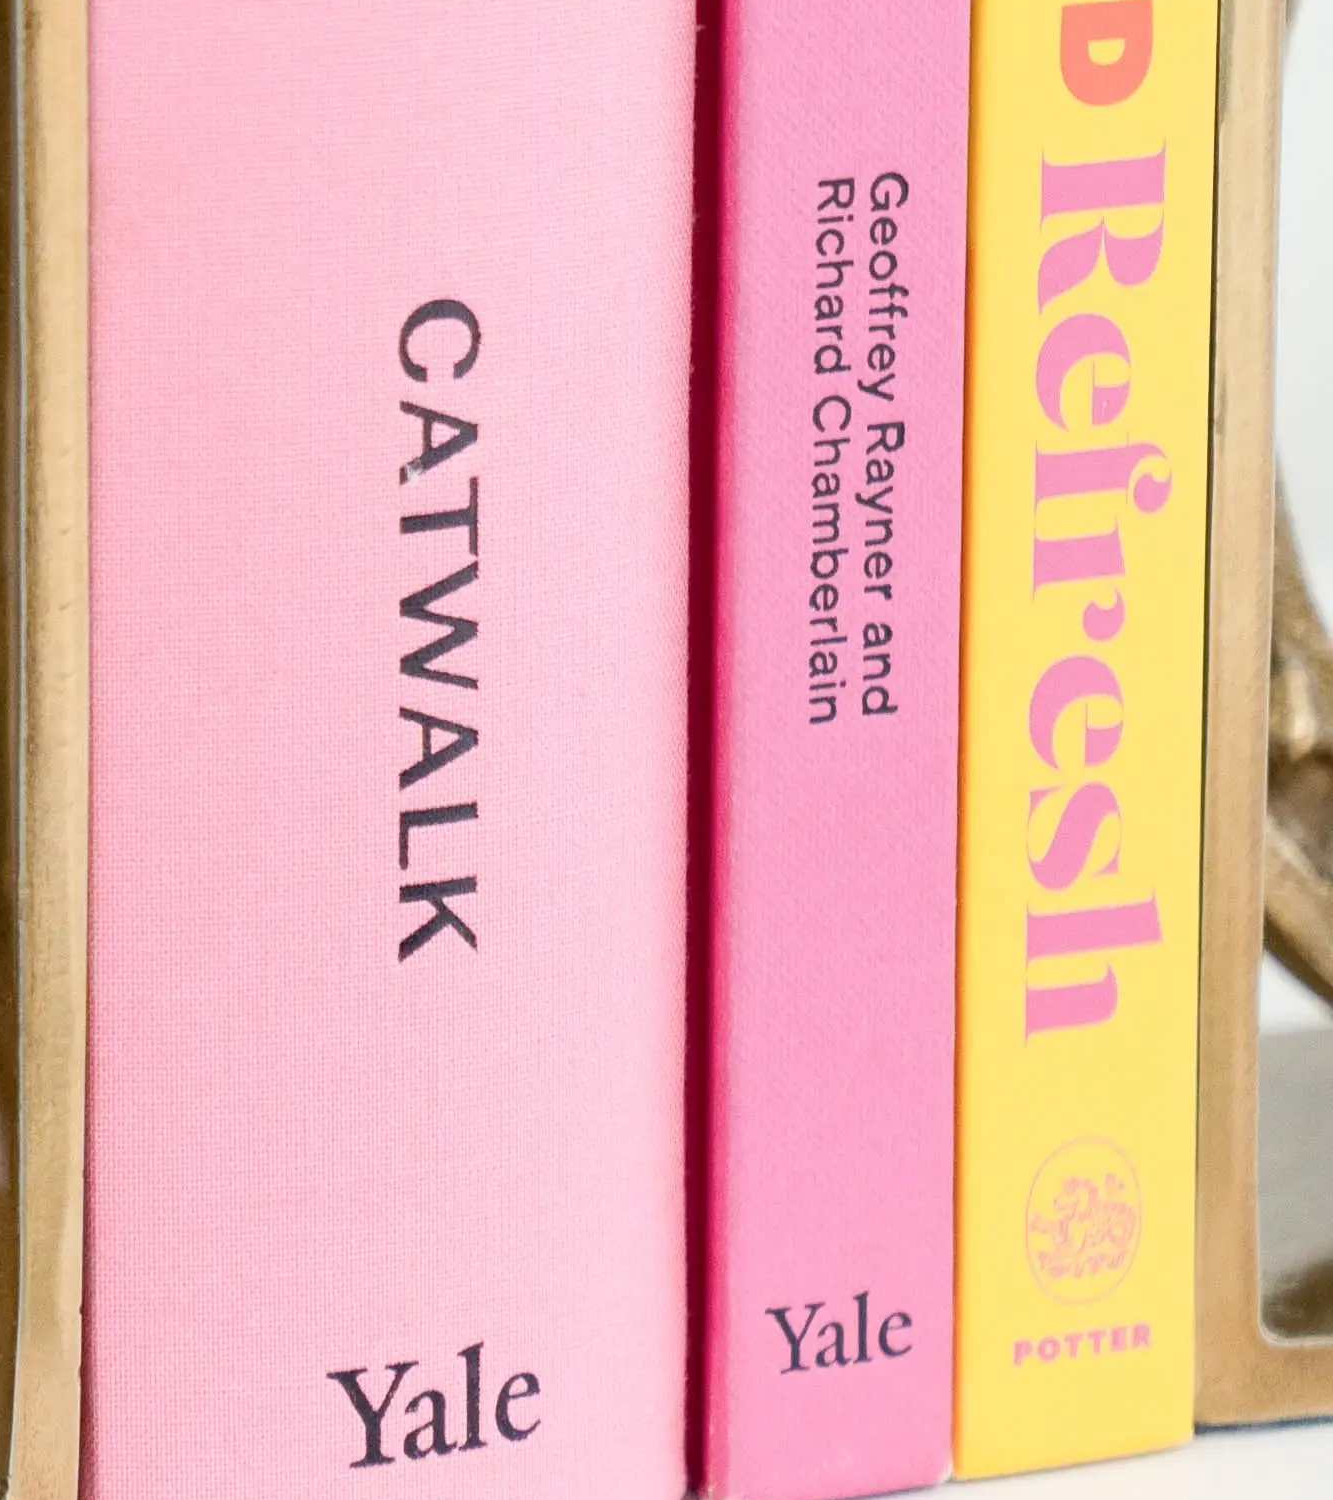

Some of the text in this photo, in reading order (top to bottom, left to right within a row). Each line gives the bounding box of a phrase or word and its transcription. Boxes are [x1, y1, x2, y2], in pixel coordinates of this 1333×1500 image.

[396, 297, 484, 963] CATWALK
[808, 177, 856, 727] Richard Chamberlain
[854, 171, 910, 717] Geoffrey Rayner and
[1021, 138, 1171, 1042] Refresh
[326, 1341, 542, 1470] Yale
[764, 1291, 914, 1374] Yale
[1013, 1322, 1151, 1366] POTTER
